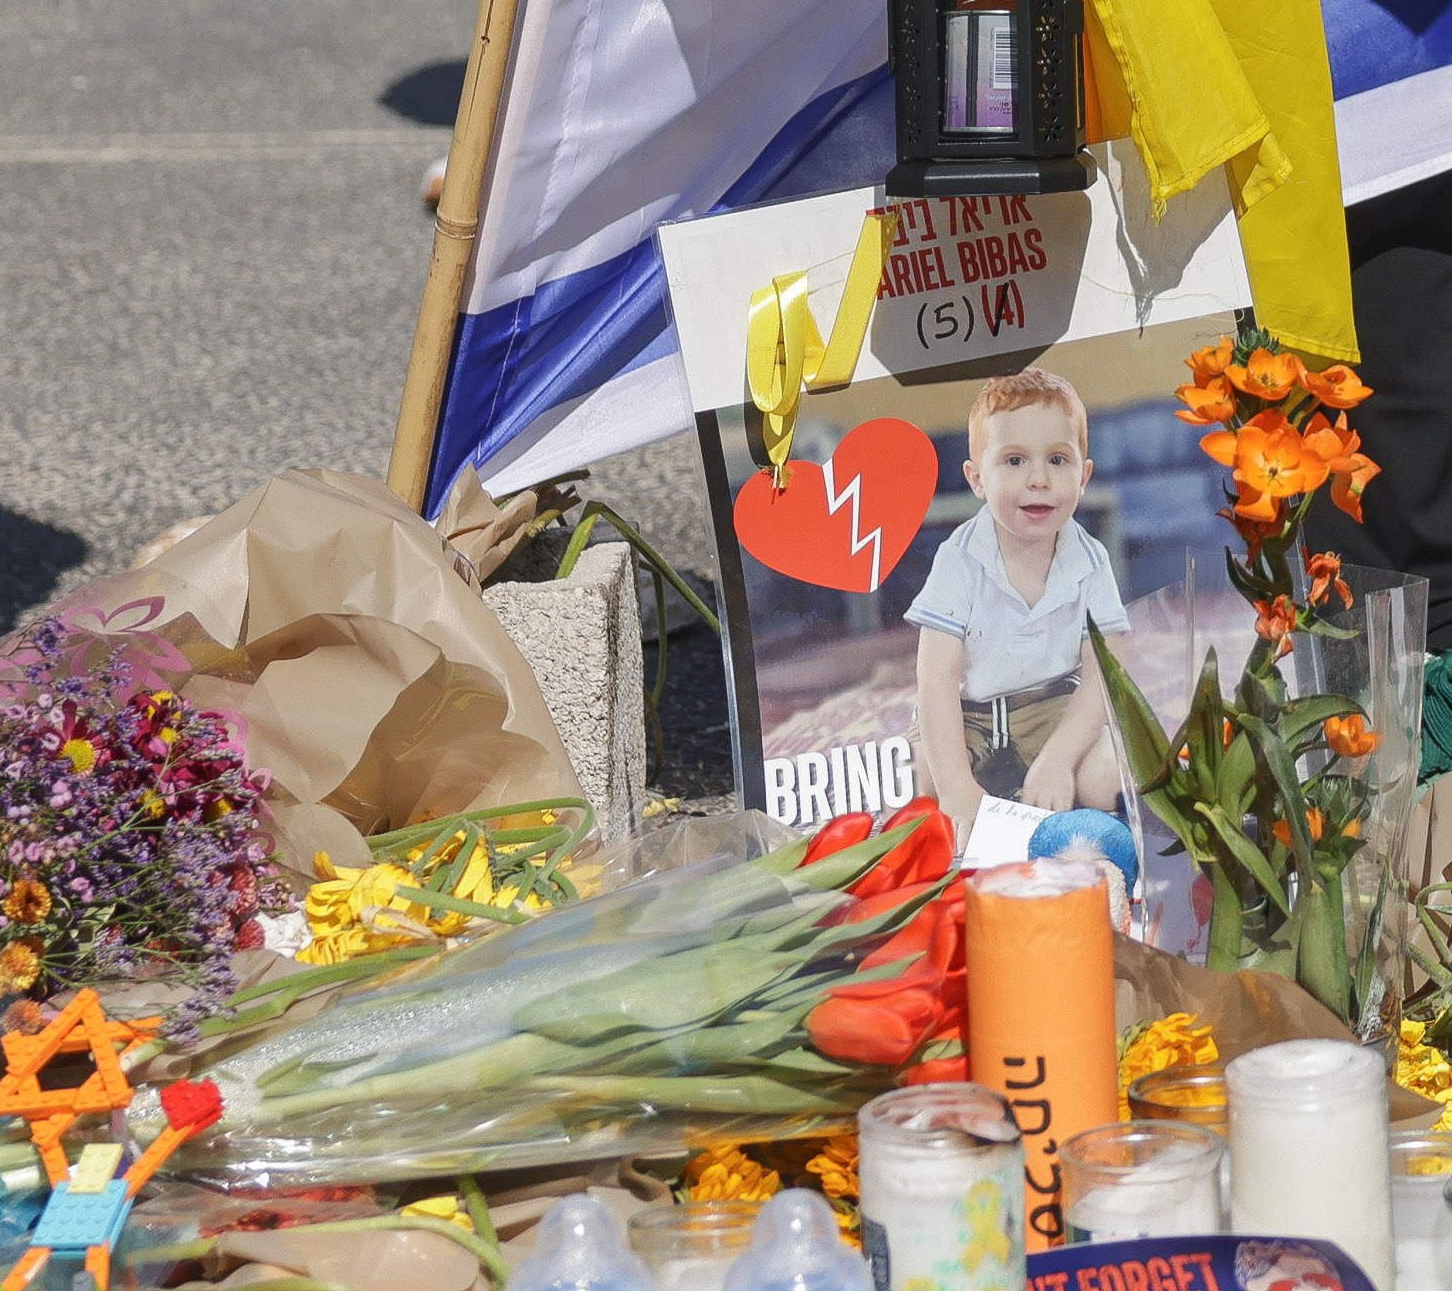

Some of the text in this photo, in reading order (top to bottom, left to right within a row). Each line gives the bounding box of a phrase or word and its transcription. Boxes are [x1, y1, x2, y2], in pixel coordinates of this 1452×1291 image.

[876, 227, 1048, 301] ARIEL BIBAS
[916, 294, 976, 349] (5)
[762, 735, 916, 824] BRING
